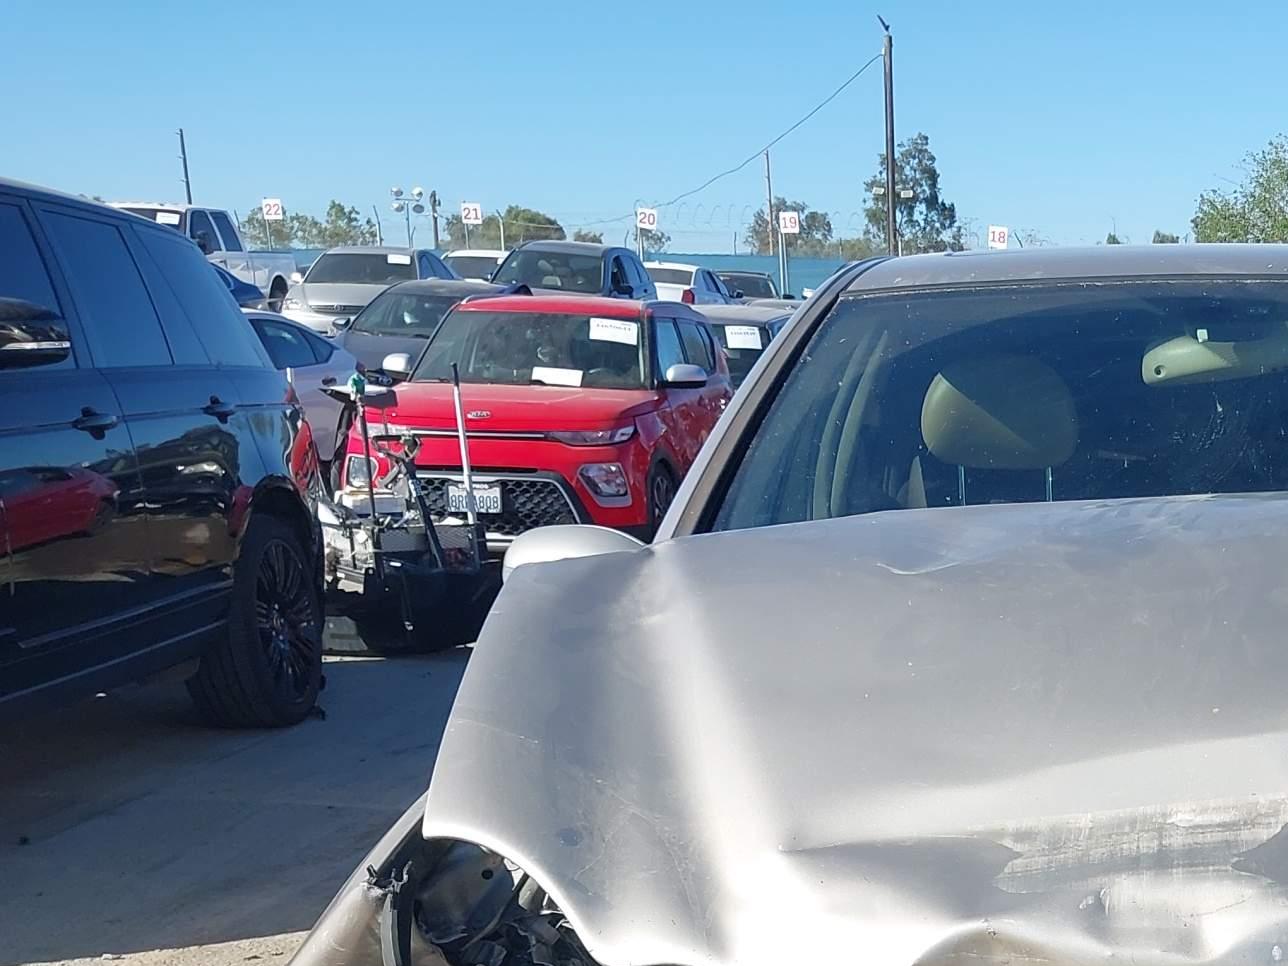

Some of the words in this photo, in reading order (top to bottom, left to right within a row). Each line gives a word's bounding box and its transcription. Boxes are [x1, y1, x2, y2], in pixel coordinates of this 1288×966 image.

[264, 203, 281, 216] 22
[463, 207, 480, 220] 21
[639, 211, 656, 226] 20
[782, 216, 797, 229] 19
[991, 230, 1006, 244] 18
[450, 494, 499, 509] 8R808
